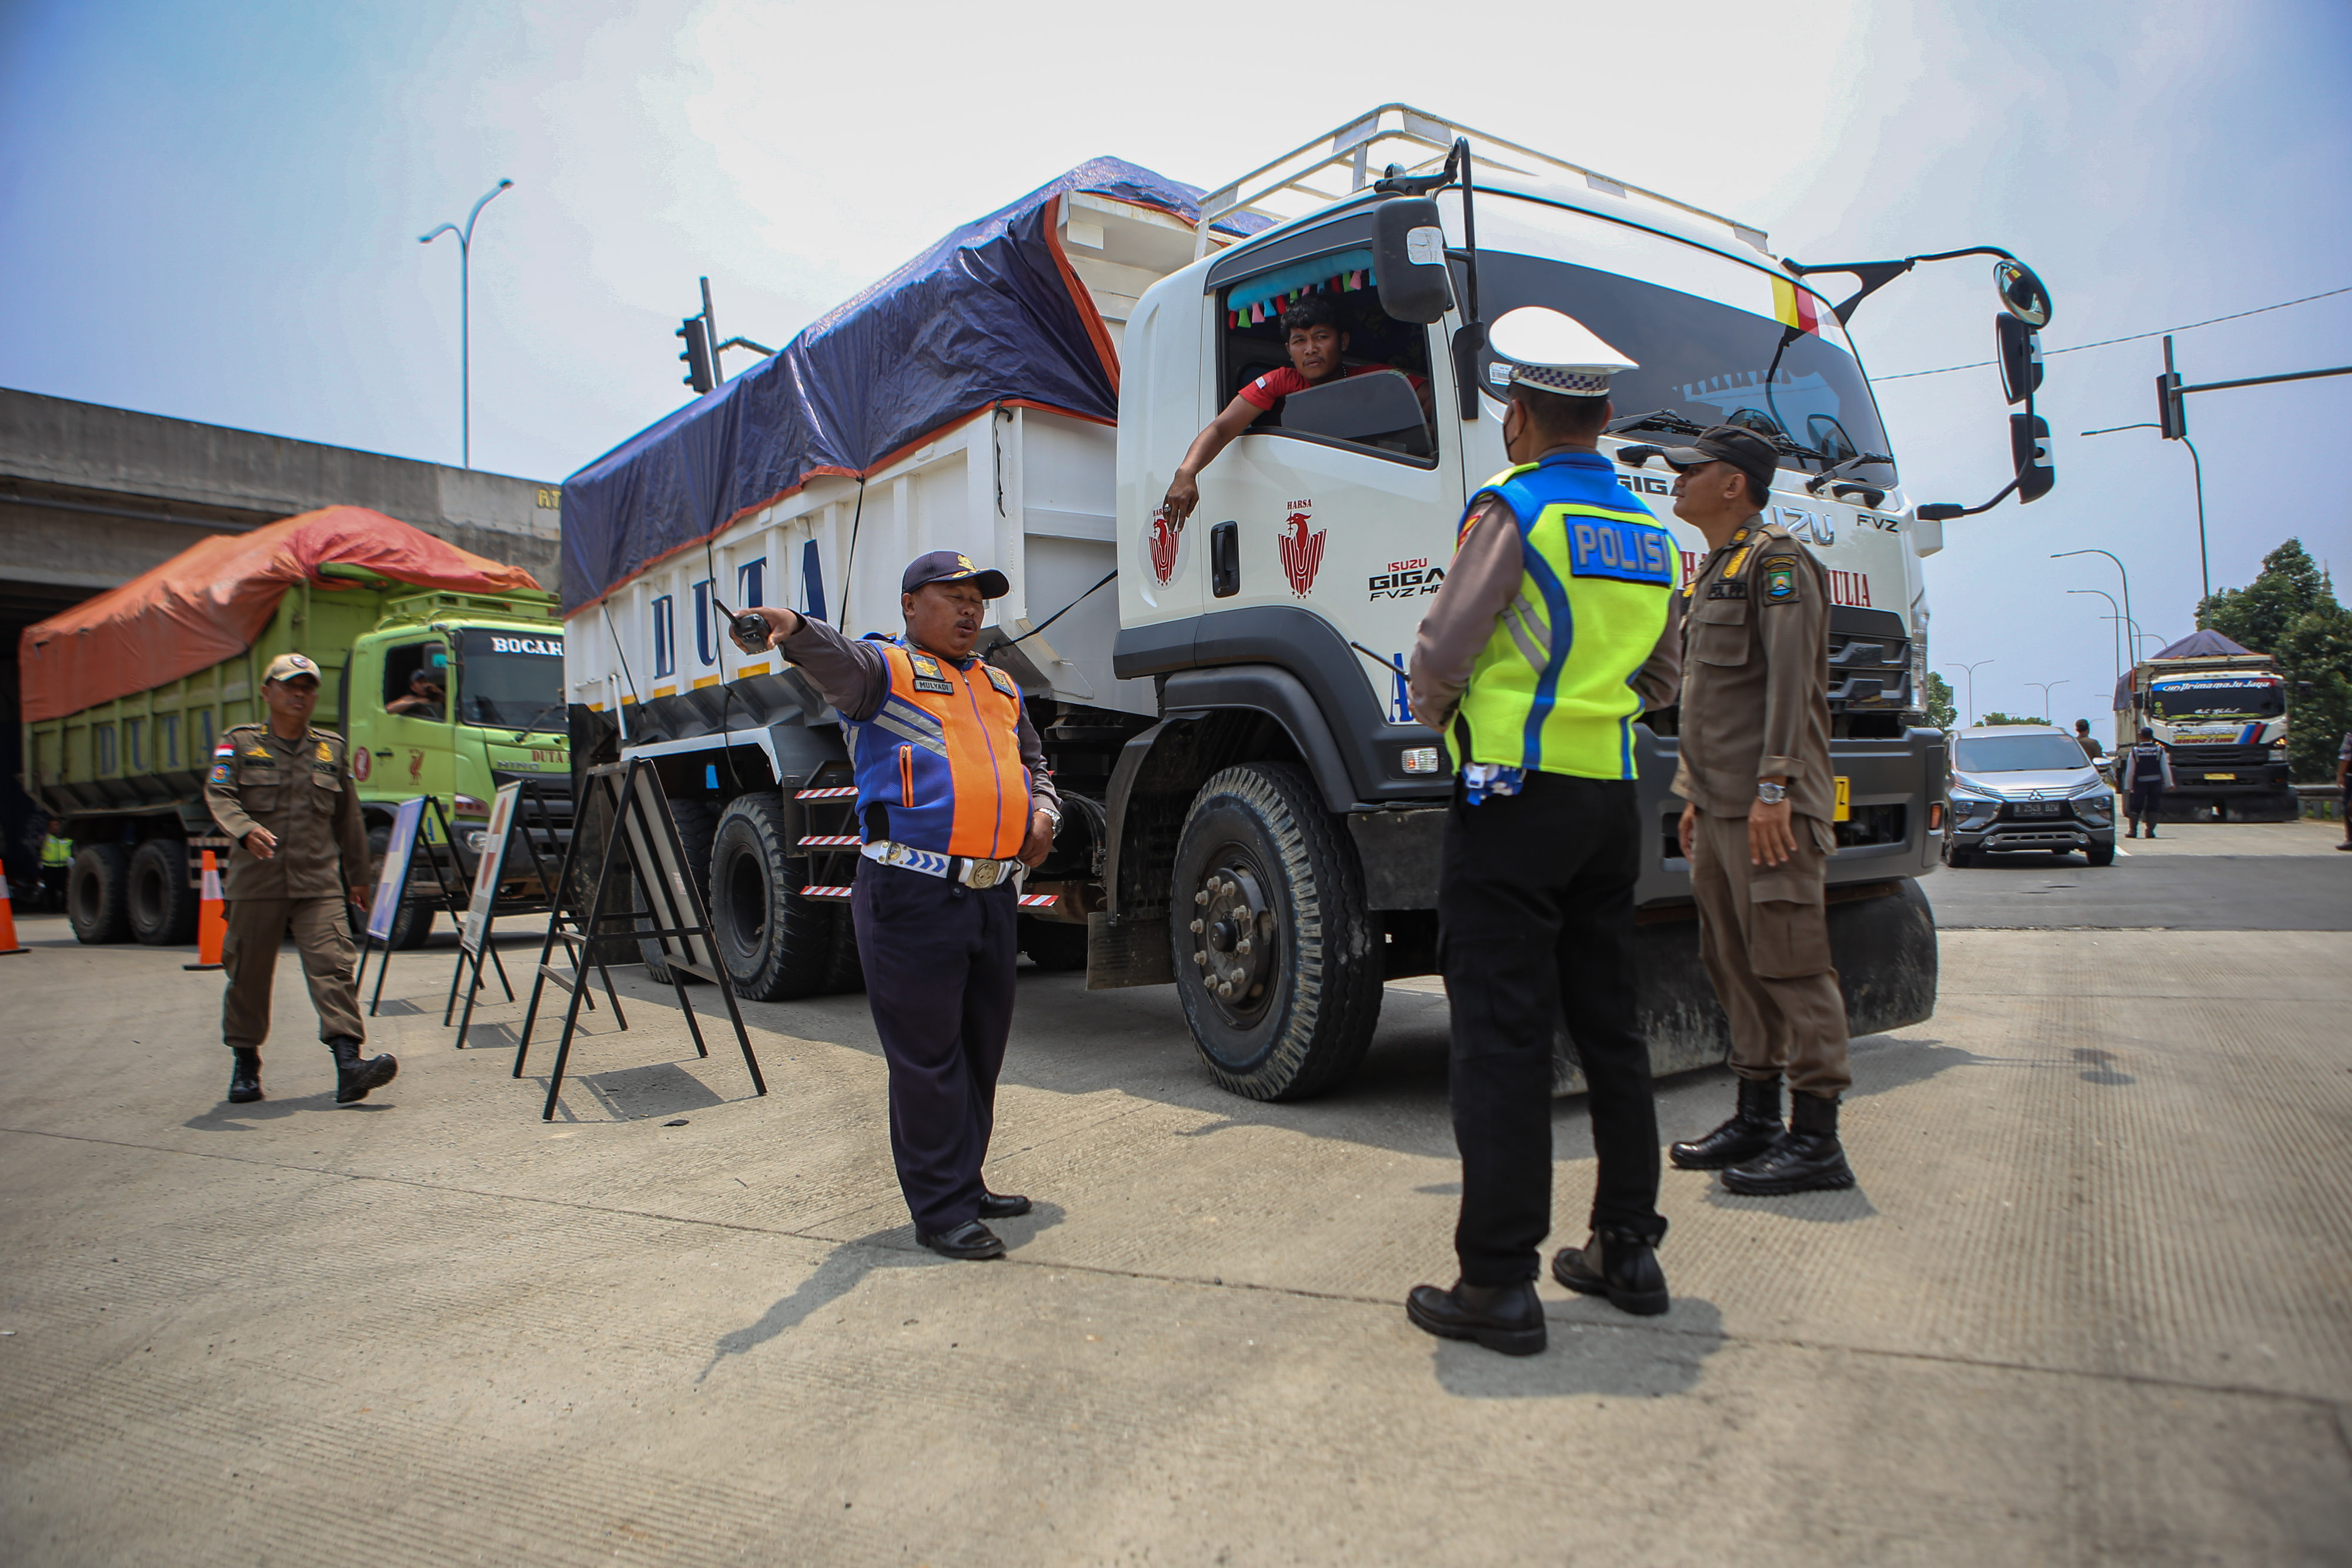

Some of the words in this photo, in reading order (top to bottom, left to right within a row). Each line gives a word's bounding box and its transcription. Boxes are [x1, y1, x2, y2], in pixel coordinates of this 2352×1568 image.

[1287, 499, 1312, 510] HARSA
[1152, 509, 1163, 517] HAR
[1857, 514, 1899, 533] FVZ
[1573, 524, 1671, 576] POLISI
[1388, 558, 1428, 572] ISUZU
[1369, 567, 1446, 591] GIGA
[1369, 588, 1415, 601] FVZ
[1826, 569, 1871, 607] ULIA
[651, 539, 827, 680] DUTA
[490, 637, 564, 656] BOCAH
[919, 681, 948, 691] MULYADI
[99, 711, 214, 775] DUTA
[532, 750, 564, 763] DUTA
[497, 760, 540, 771] HINO
